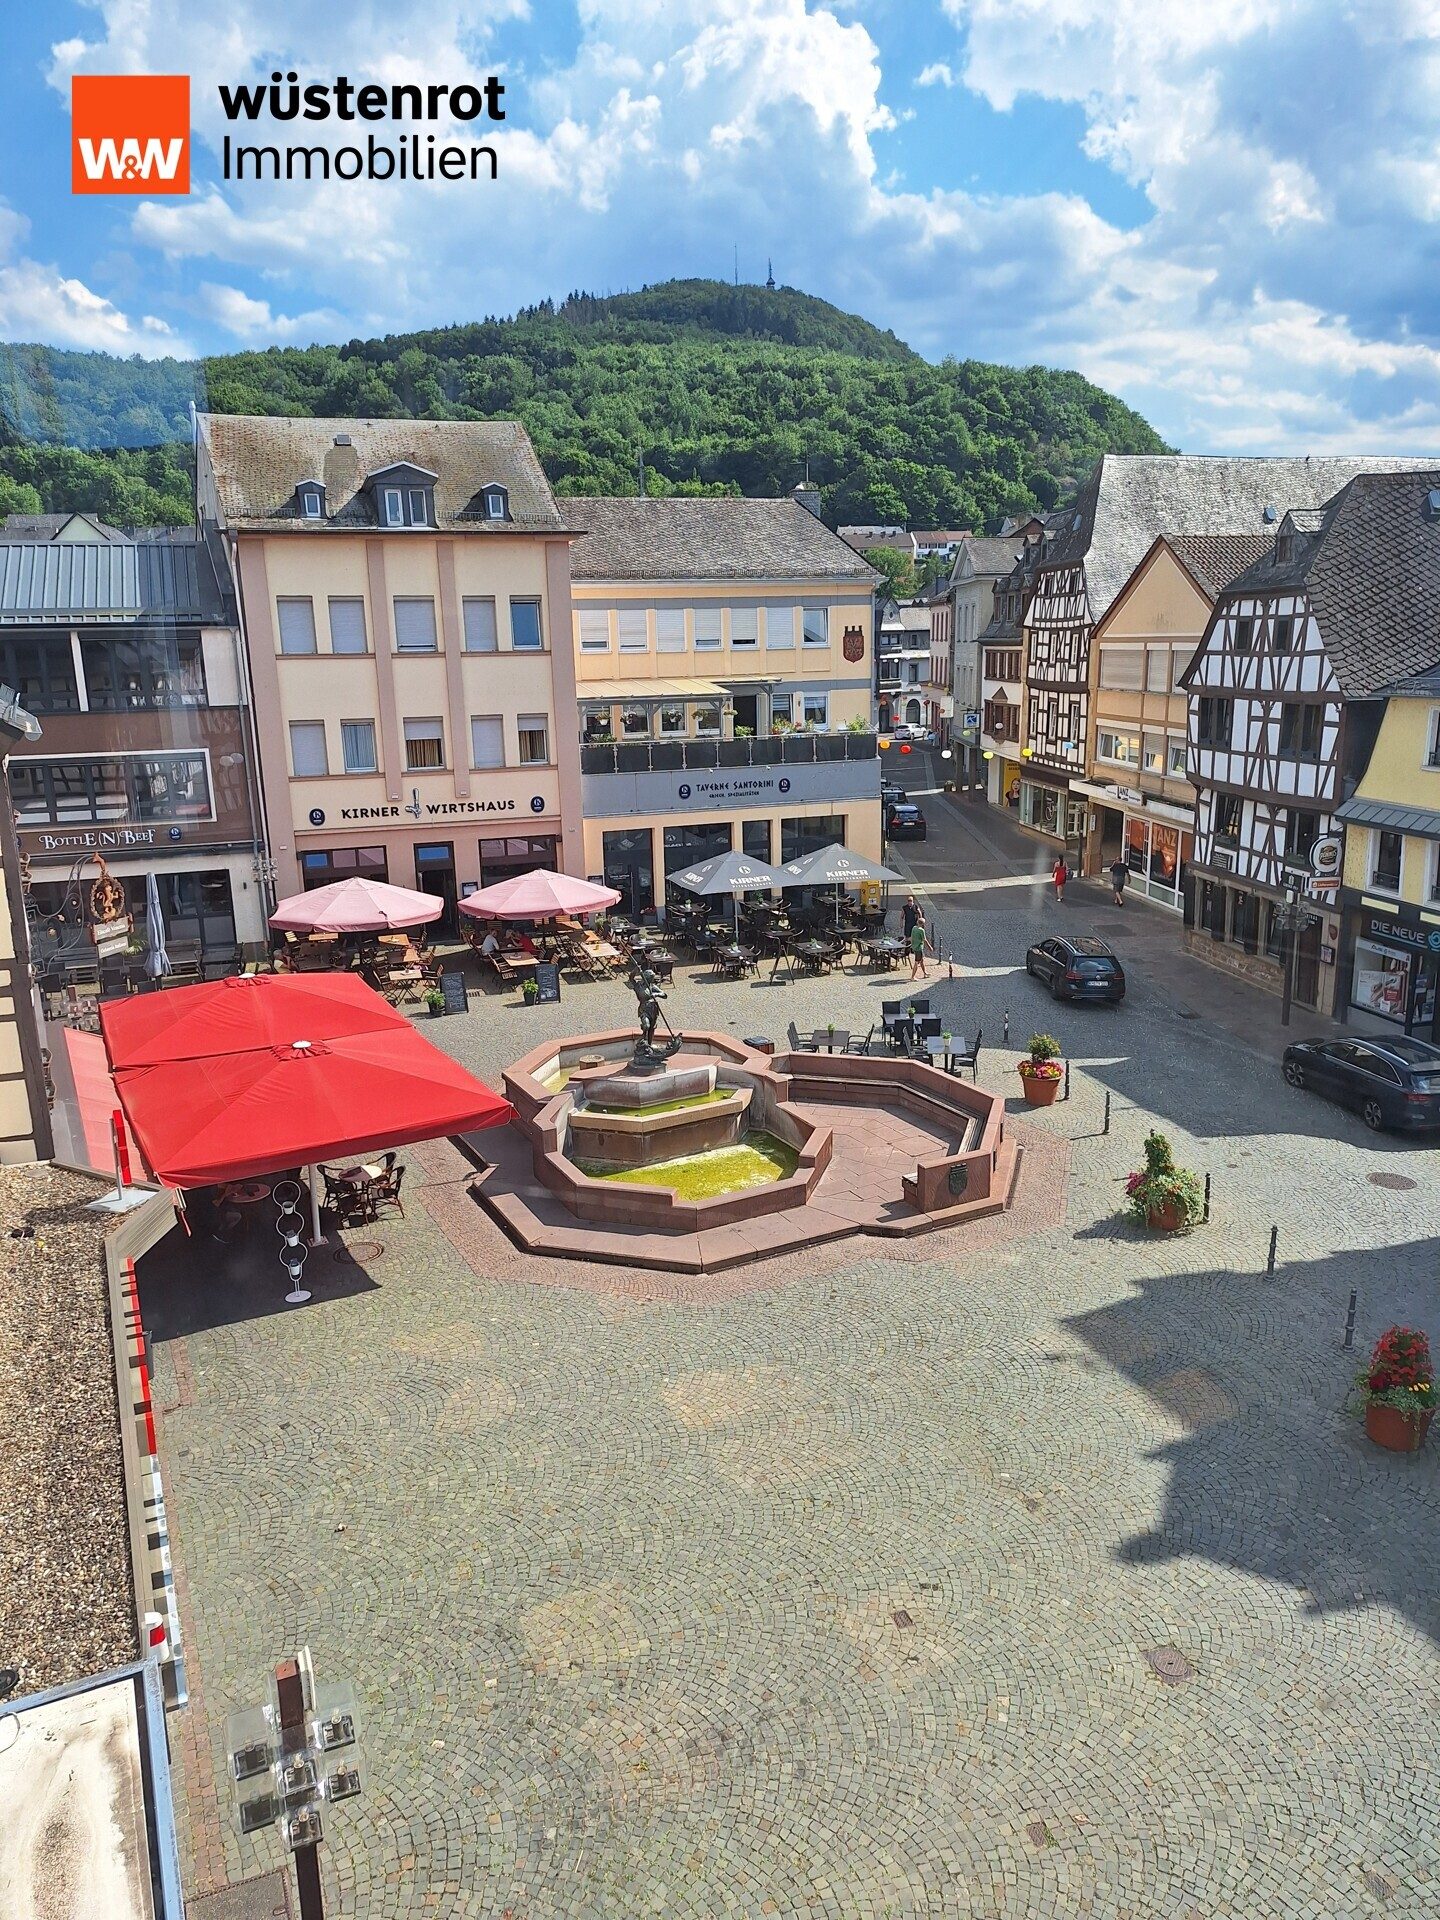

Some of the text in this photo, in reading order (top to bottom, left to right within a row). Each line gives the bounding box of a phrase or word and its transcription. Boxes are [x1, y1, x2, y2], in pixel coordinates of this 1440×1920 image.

[696, 780, 774, 792] TAVERNE SANTORINI
[341, 800, 516, 820] KIRNER WIRTSHAUS
[825, 869, 869, 878] KIRNER
[729, 875, 772, 885] KIRNER
[1371, 919, 1426, 944] DIE NEUE
